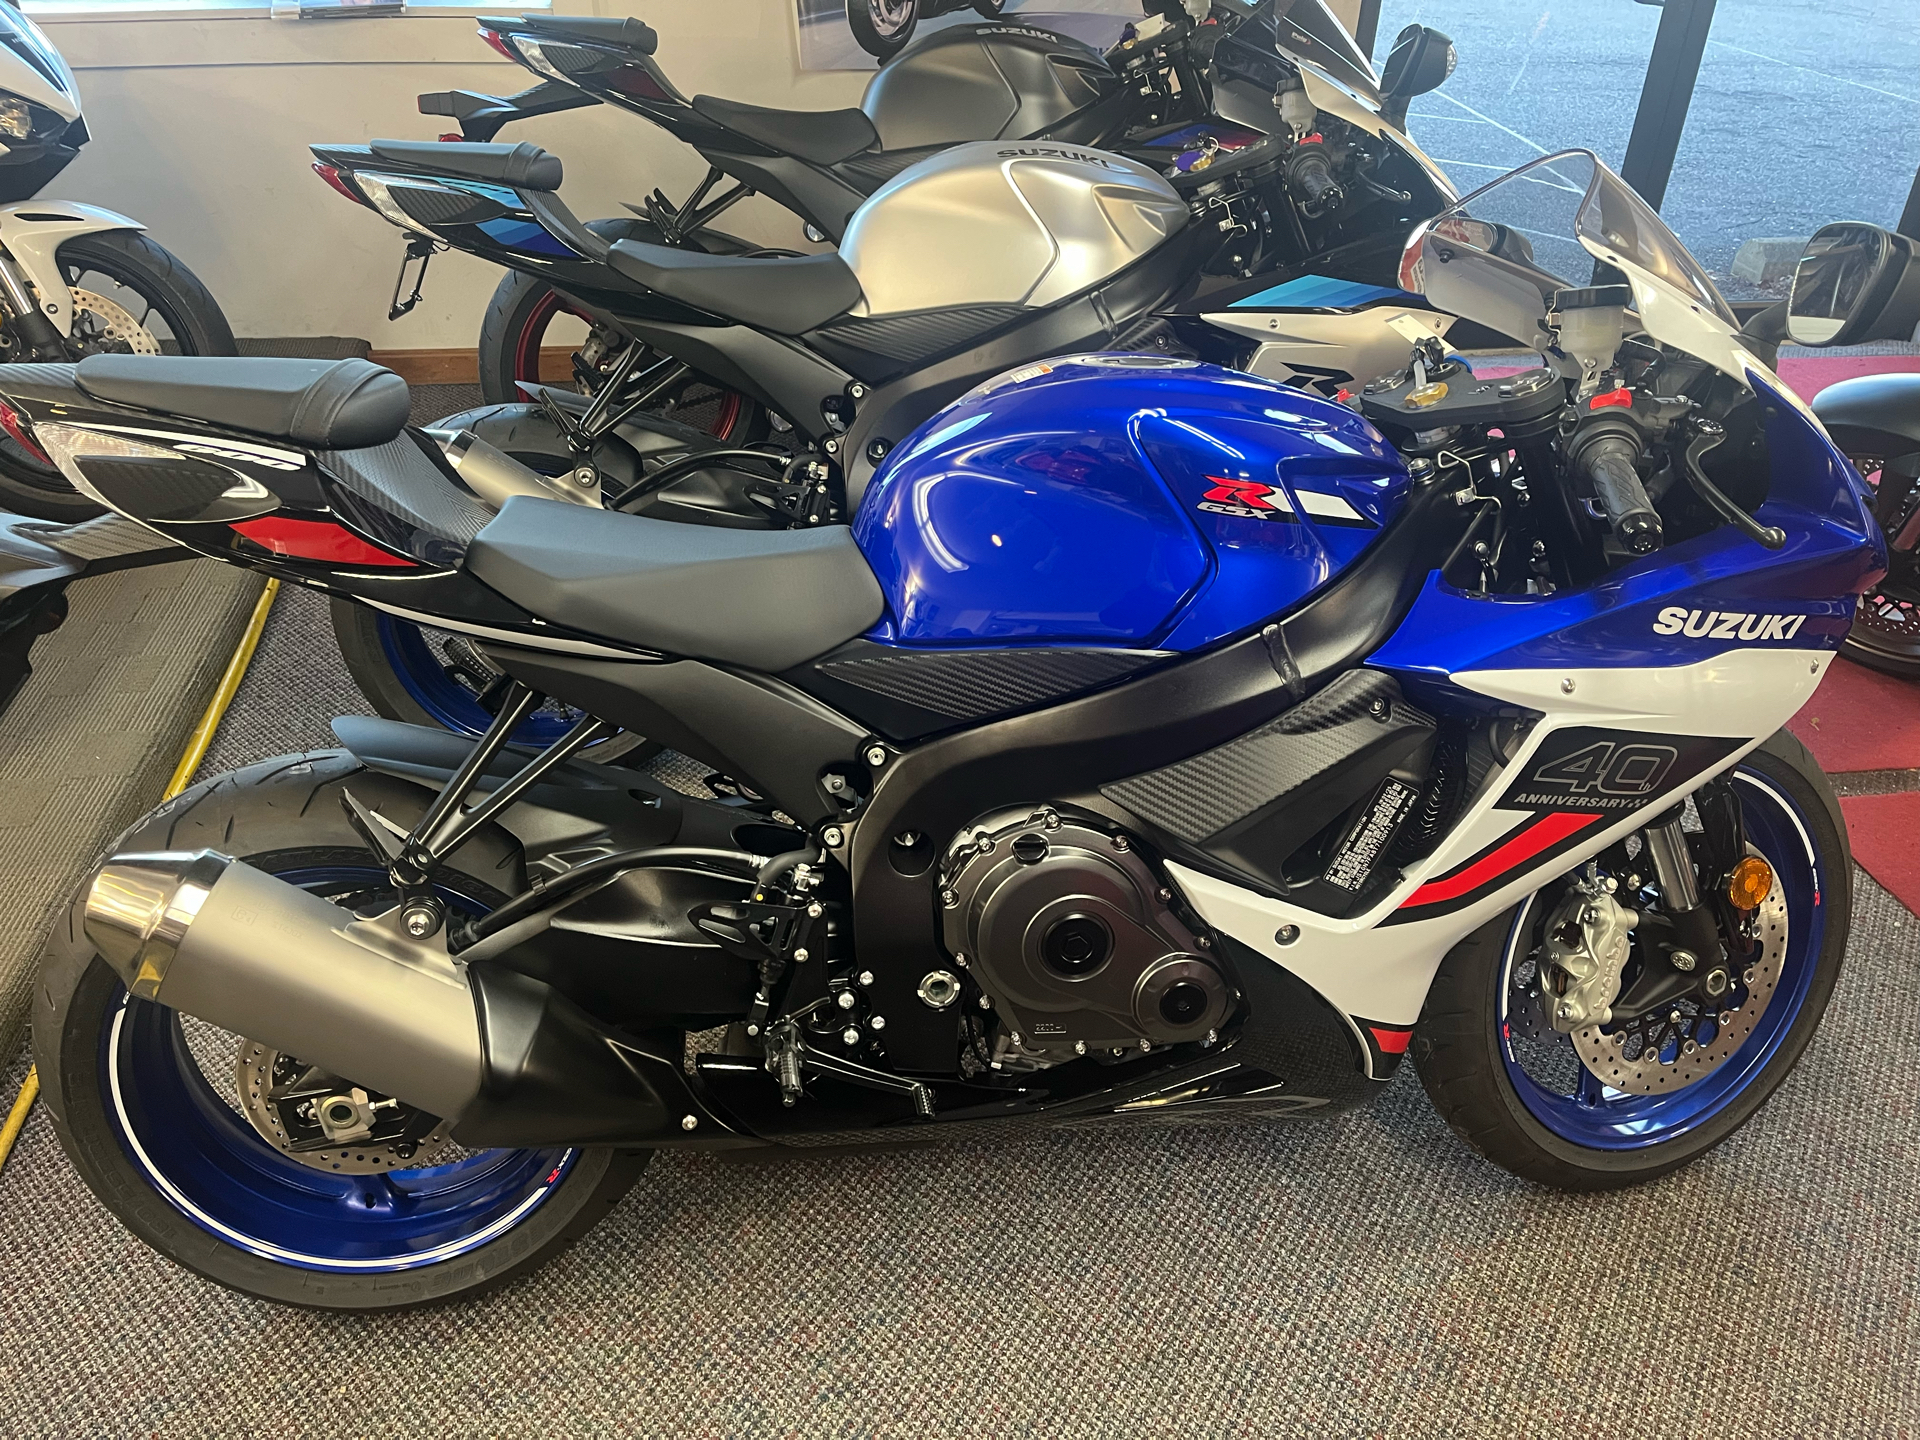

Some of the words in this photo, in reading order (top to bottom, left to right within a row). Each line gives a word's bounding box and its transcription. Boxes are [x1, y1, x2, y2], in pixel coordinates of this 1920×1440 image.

[975, 27, 1058, 44] SUZUKI
[996, 148, 1110, 169] SUZUKI
[1202, 475, 1277, 510] R
[1196, 501, 1277, 520] GSX
[1652, 606, 1807, 641] SUZUKI
[1513, 793, 1631, 808] ANNIVERSARY
[1593, 935, 1625, 1009] brembo
